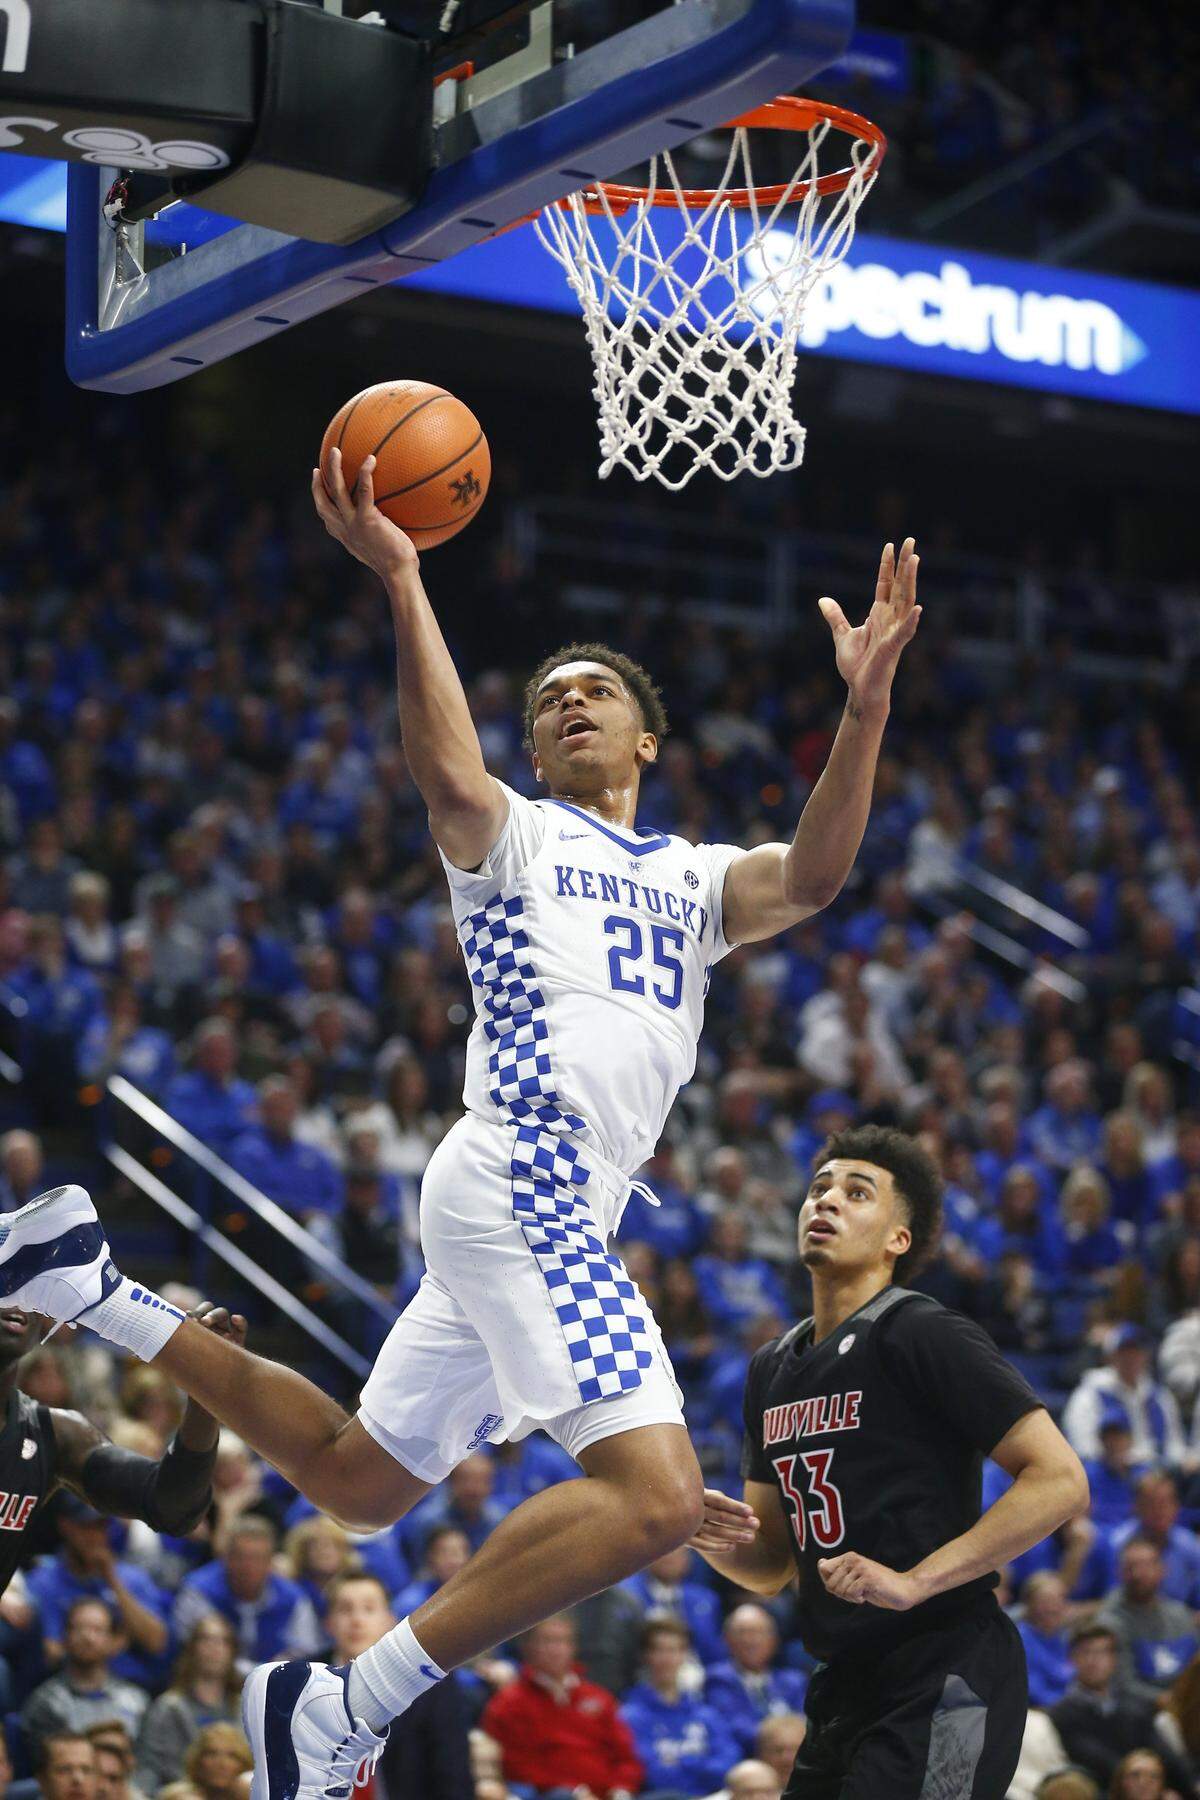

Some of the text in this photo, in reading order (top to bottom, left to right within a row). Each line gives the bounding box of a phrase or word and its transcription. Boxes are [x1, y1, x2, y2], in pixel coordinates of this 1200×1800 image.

[743, 229, 1124, 375] Spectrum
[555, 866, 707, 943] KENTUCKY
[604, 915, 684, 1009] 25
[772, 1448, 844, 1551] 33
